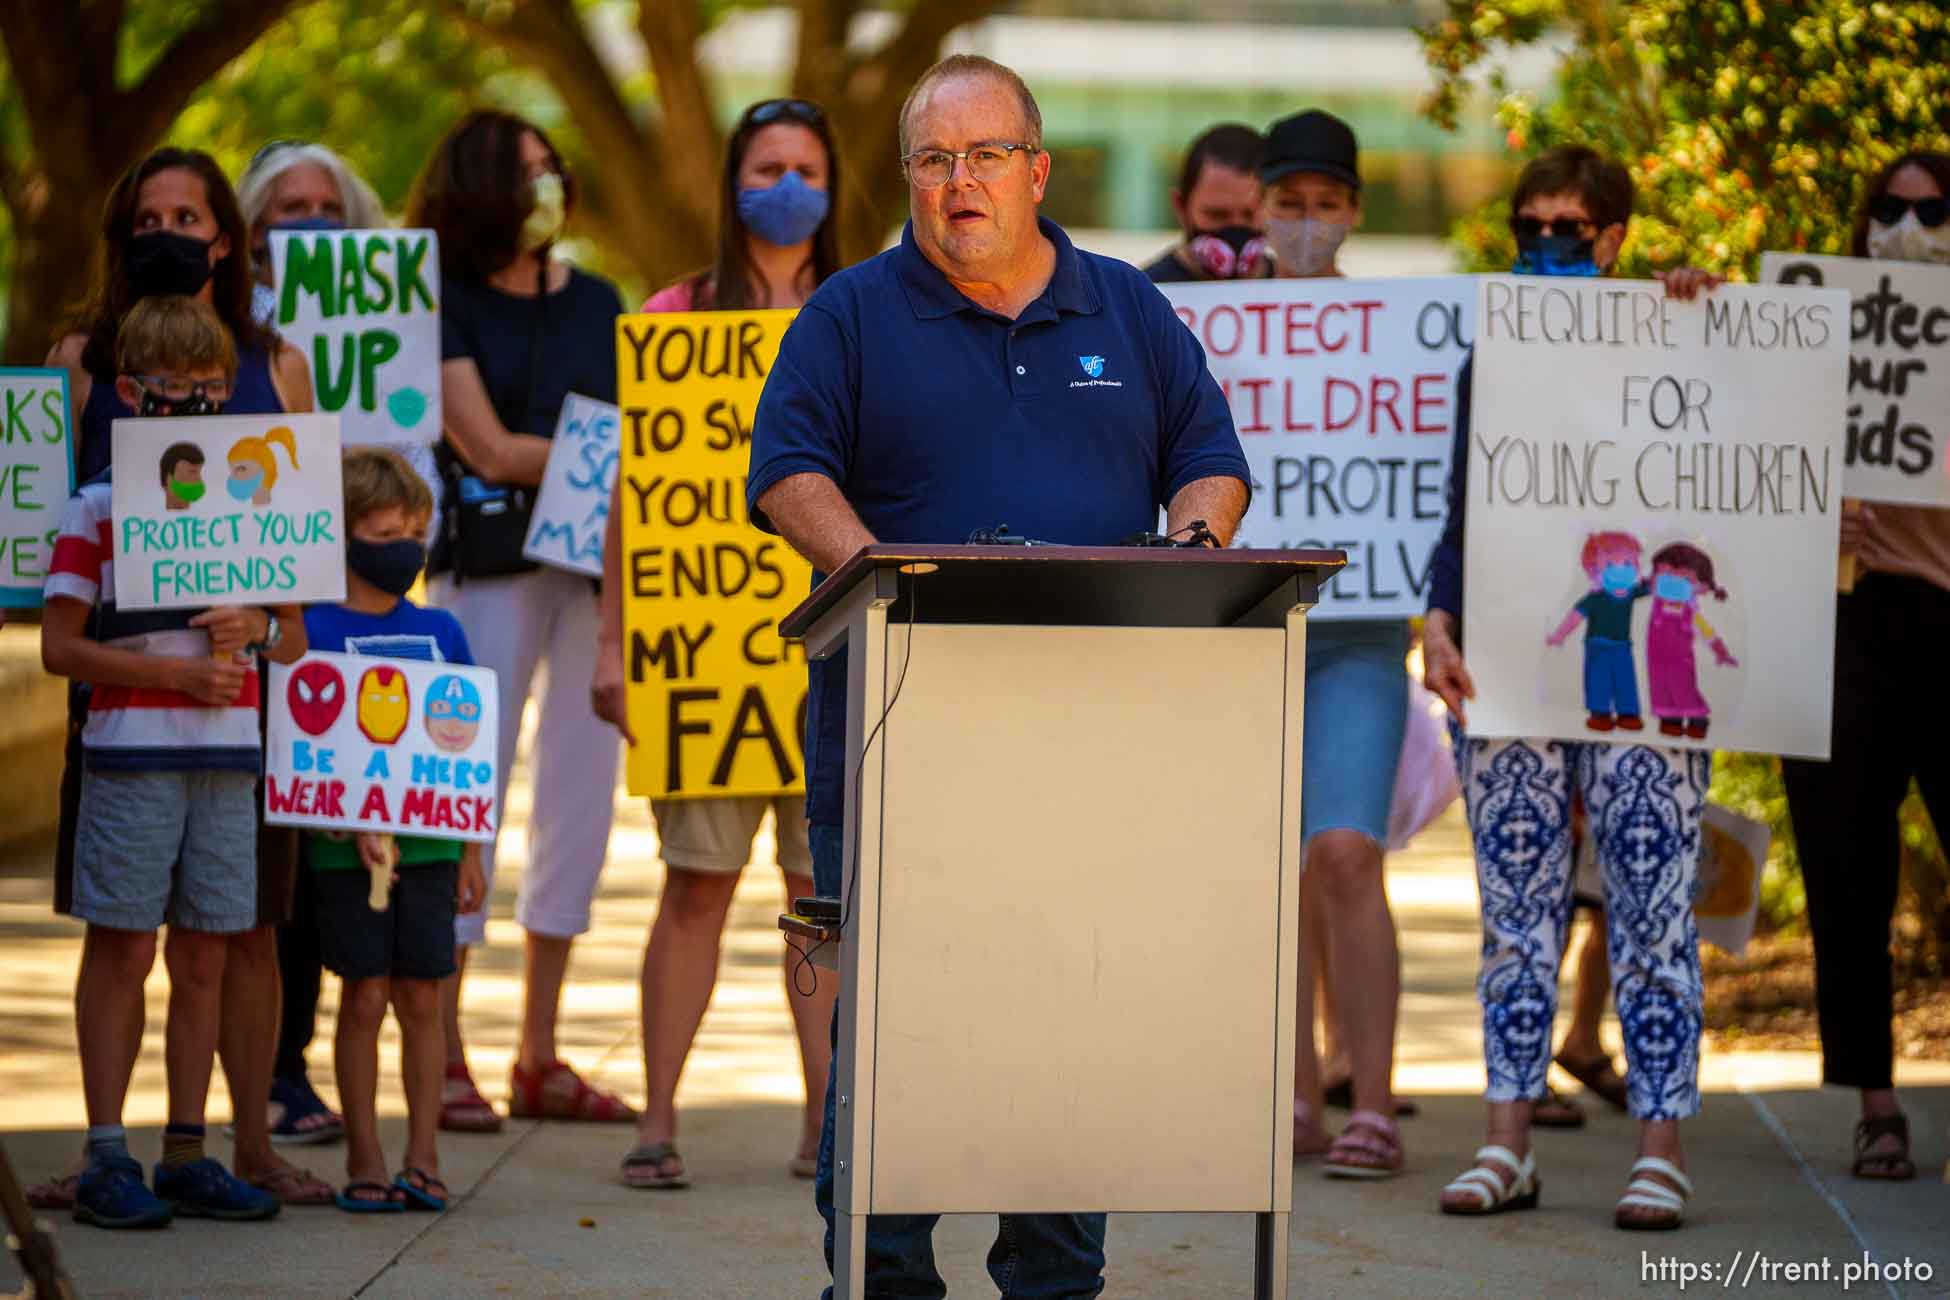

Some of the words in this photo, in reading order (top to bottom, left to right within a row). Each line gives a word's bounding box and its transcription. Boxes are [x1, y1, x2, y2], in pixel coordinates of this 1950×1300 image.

[279, 233, 437, 326] MASK
[1486, 282, 1677, 347] REQUIRE
[1704, 299, 1833, 348] MASKS
[314, 330, 400, 413] UP
[623, 322, 764, 382] YOUR
[0, 388, 64, 444] KS
[625, 408, 684, 457] TO
[1221, 375, 1450, 434] ILDRE
[1622, 375, 1712, 432] FOR
[1273, 456, 1451, 519] PROTE
[1475, 435, 1621, 506] YOUNG
[1635, 440, 1831, 515] CHILDREN
[122, 513, 244, 554] PROTECT
[253, 509, 336, 545] YOUR
[152, 555, 297, 603] FRIENDS
[631, 542, 785, 600] ENDS
[631, 620, 714, 683] MY
[292, 740, 335, 773] BE
[363, 749, 390, 779] A
[411, 753, 492, 789] HERO
[667, 685, 808, 793] FA
[266, 775, 345, 818] WEAR
[359, 784, 391, 822] A
[400, 787, 495, 832] MASK
